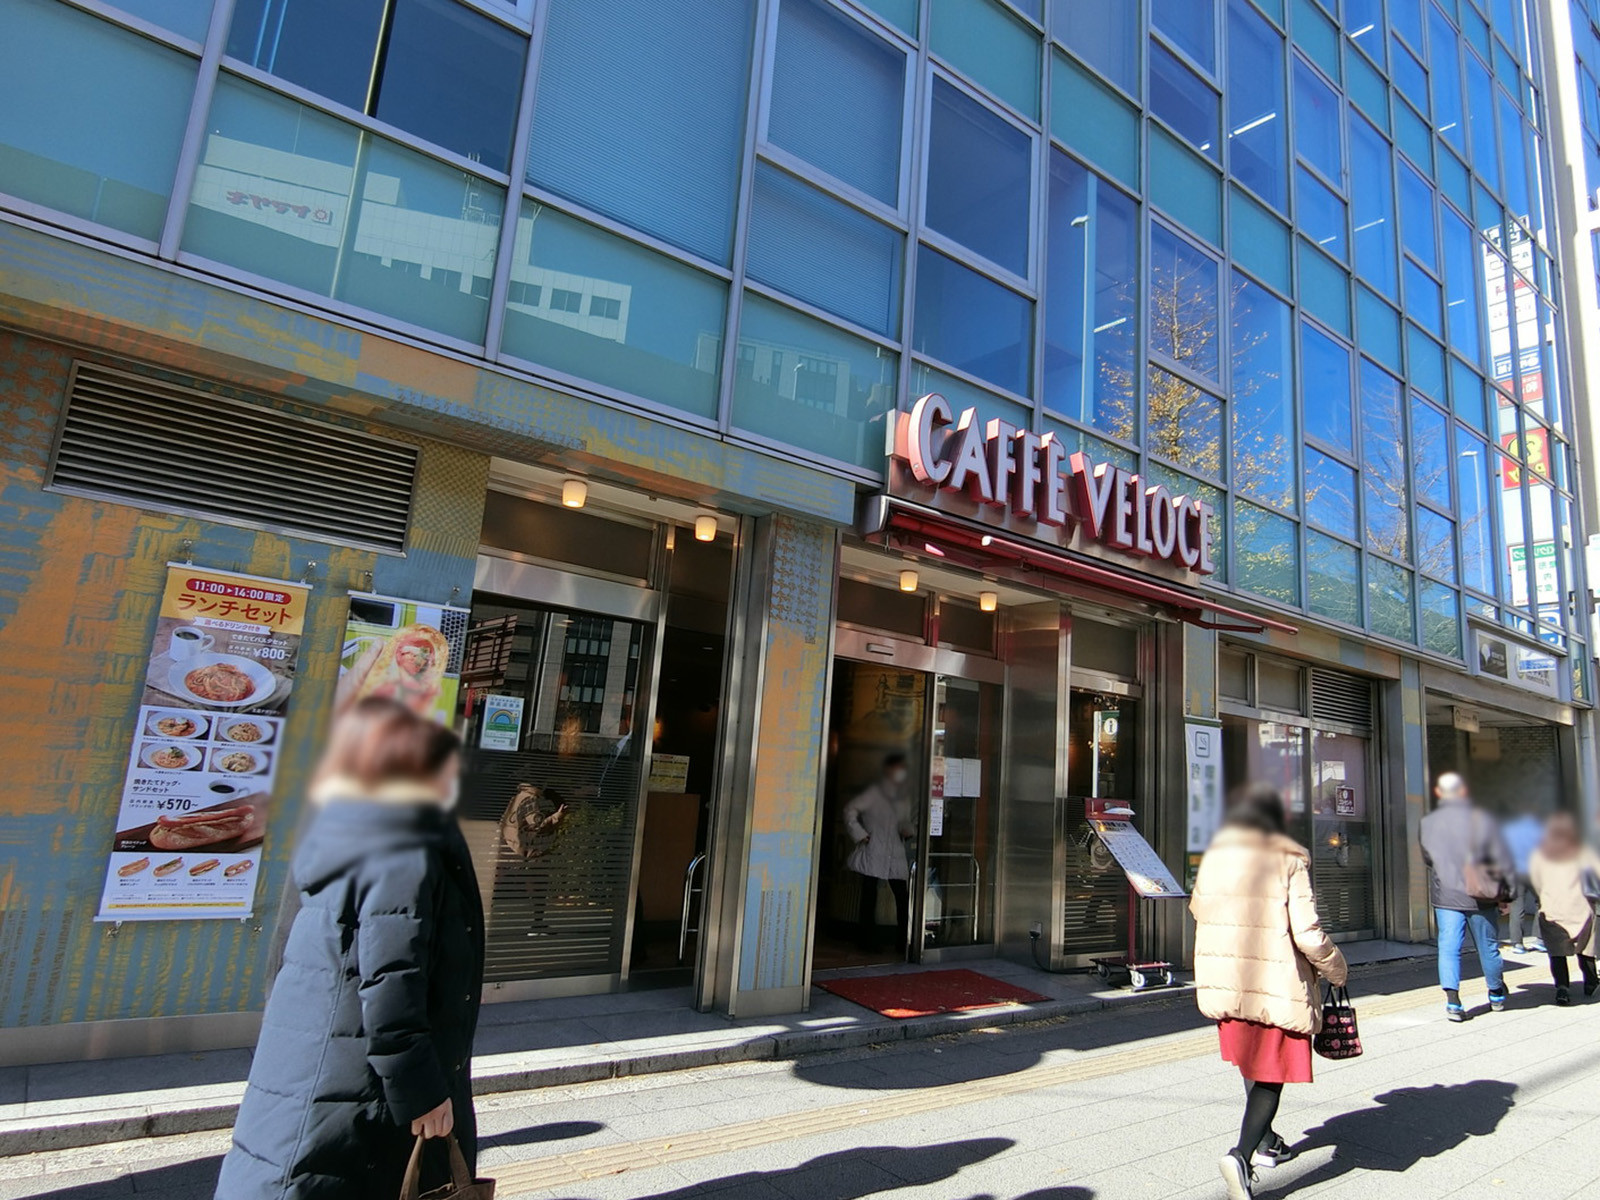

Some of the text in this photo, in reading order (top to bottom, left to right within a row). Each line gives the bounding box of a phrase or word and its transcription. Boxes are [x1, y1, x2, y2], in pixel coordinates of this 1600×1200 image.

[1070, 452, 1216, 575] VELOCE
[178, 593, 293, 625] ランチセット
